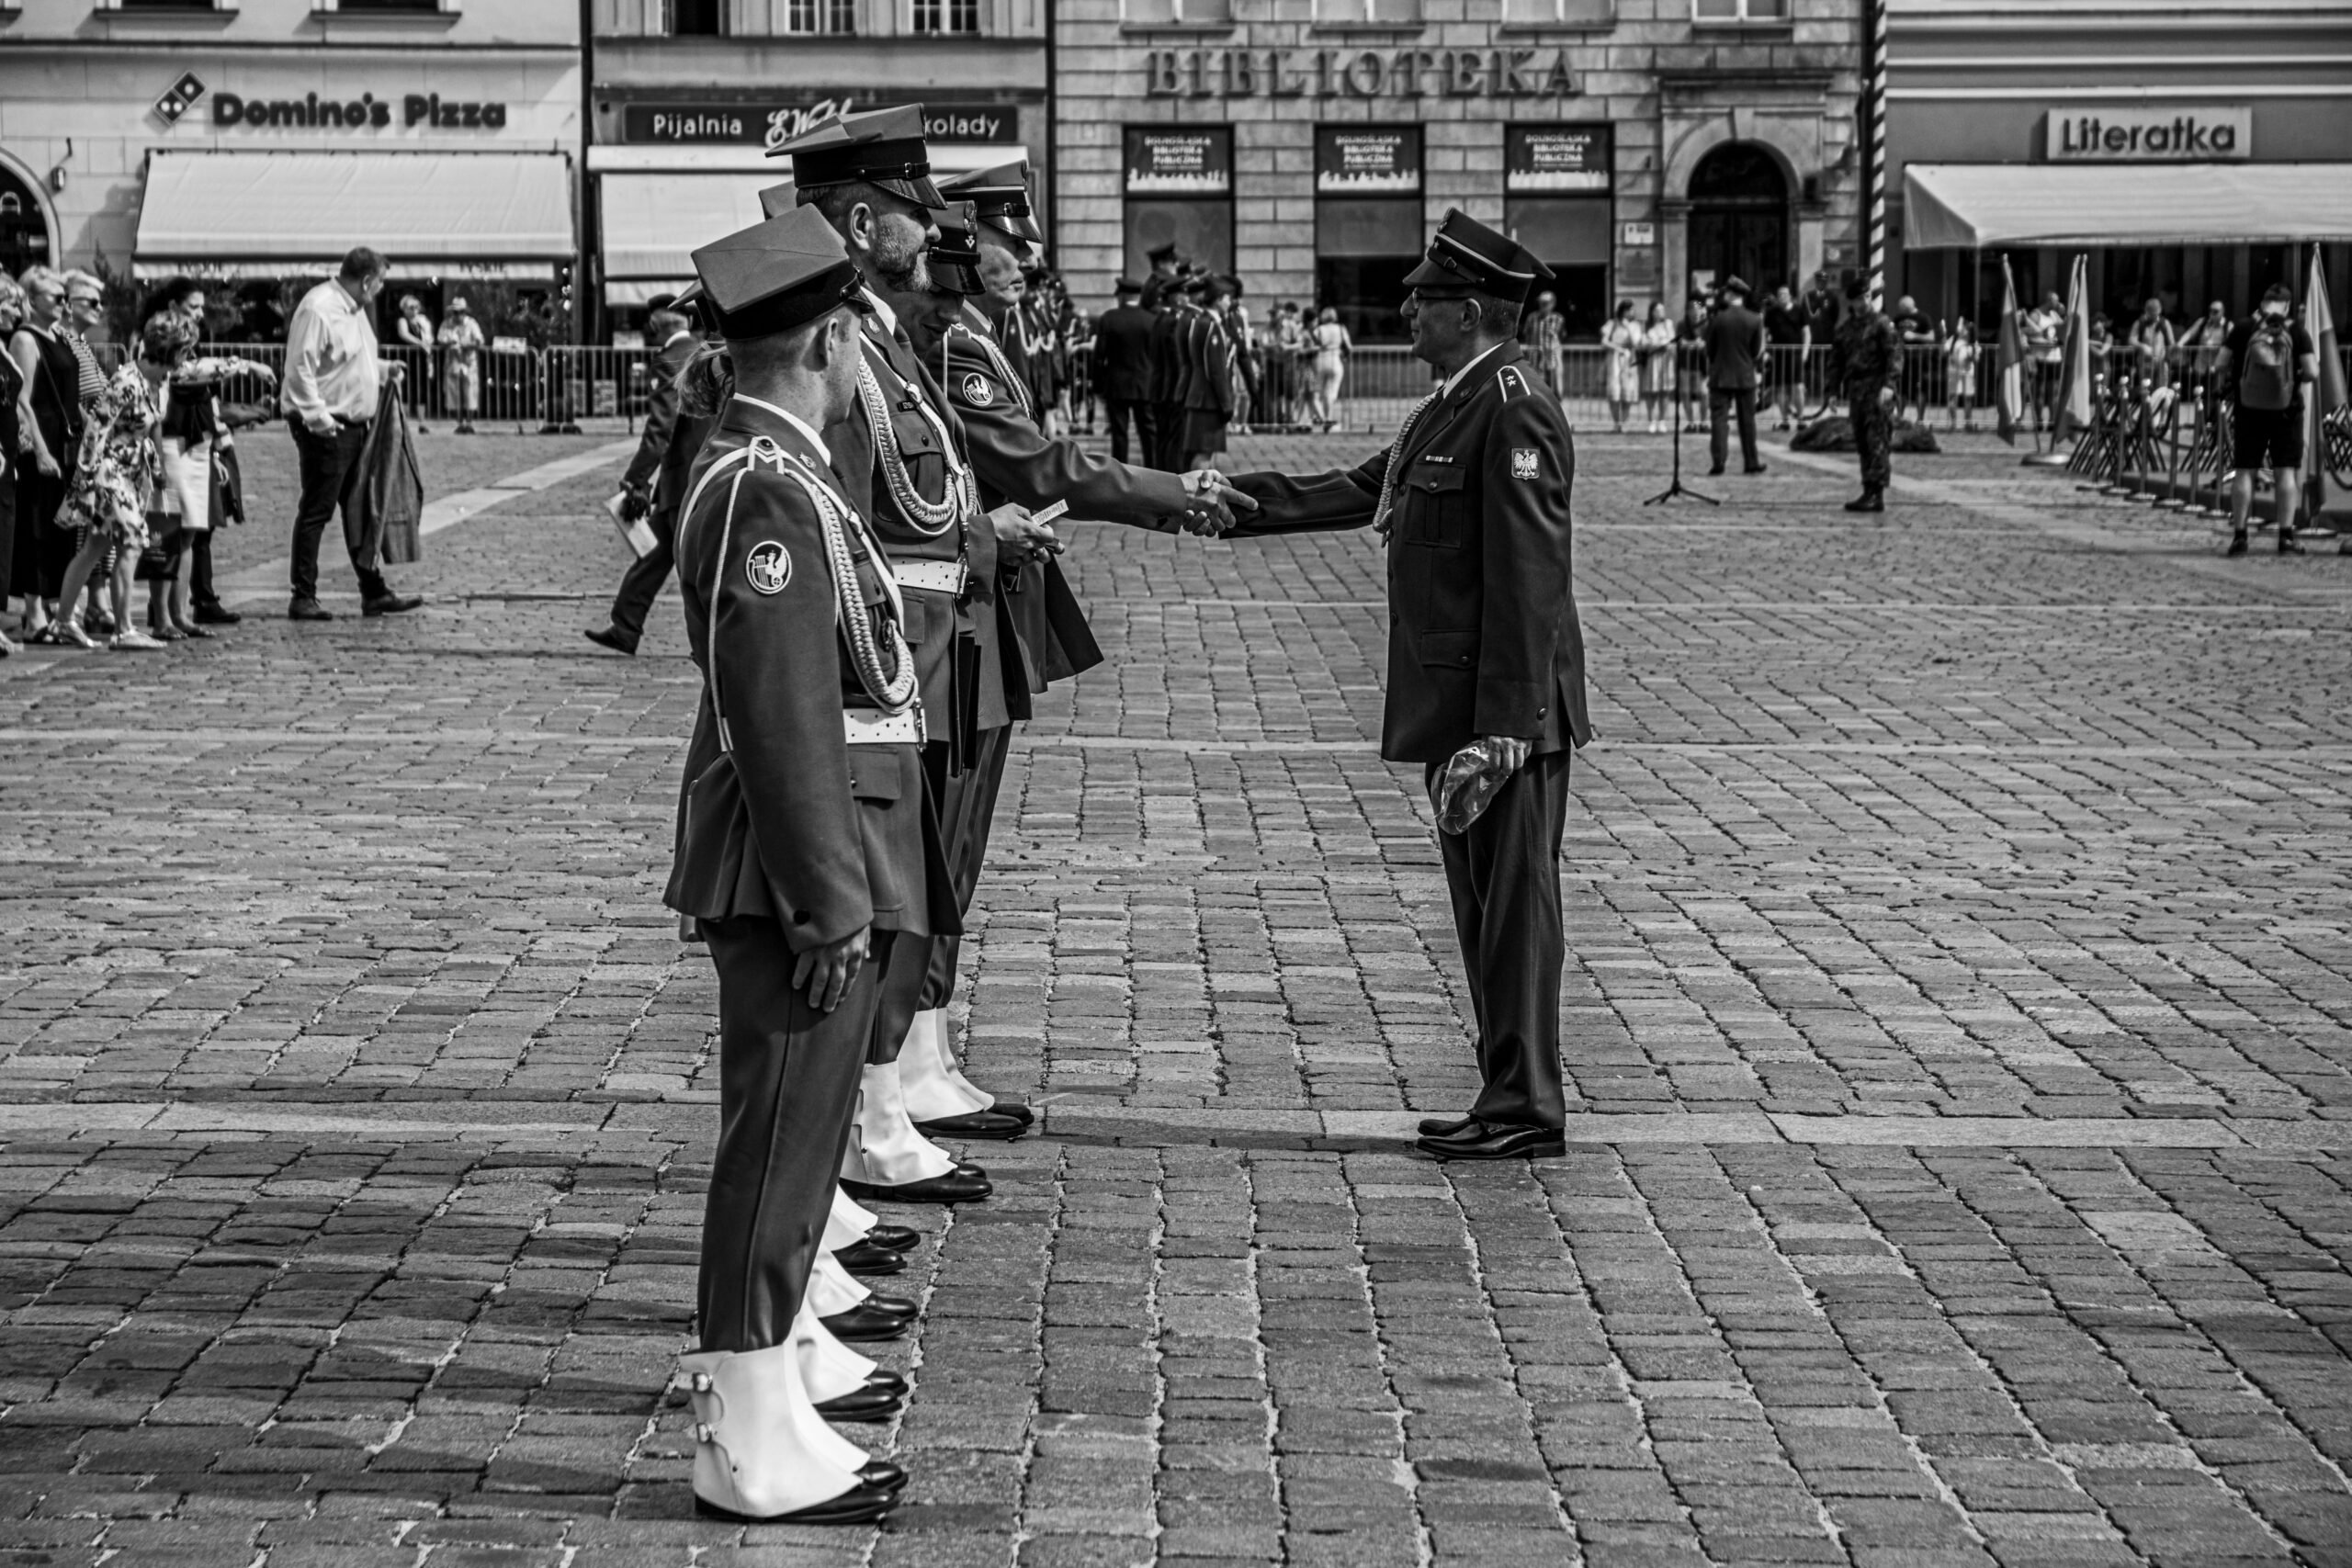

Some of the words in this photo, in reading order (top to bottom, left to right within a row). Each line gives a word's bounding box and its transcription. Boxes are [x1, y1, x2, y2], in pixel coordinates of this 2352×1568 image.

[1148, 50, 1582, 96] BIBLIOTEKA
[212, 92, 390, 128] Domino's
[404, 92, 506, 128] Pizza
[653, 112, 742, 140] Pijalnia
[924, 113, 1001, 140] kolady
[2063, 116, 2235, 152] Literatka
